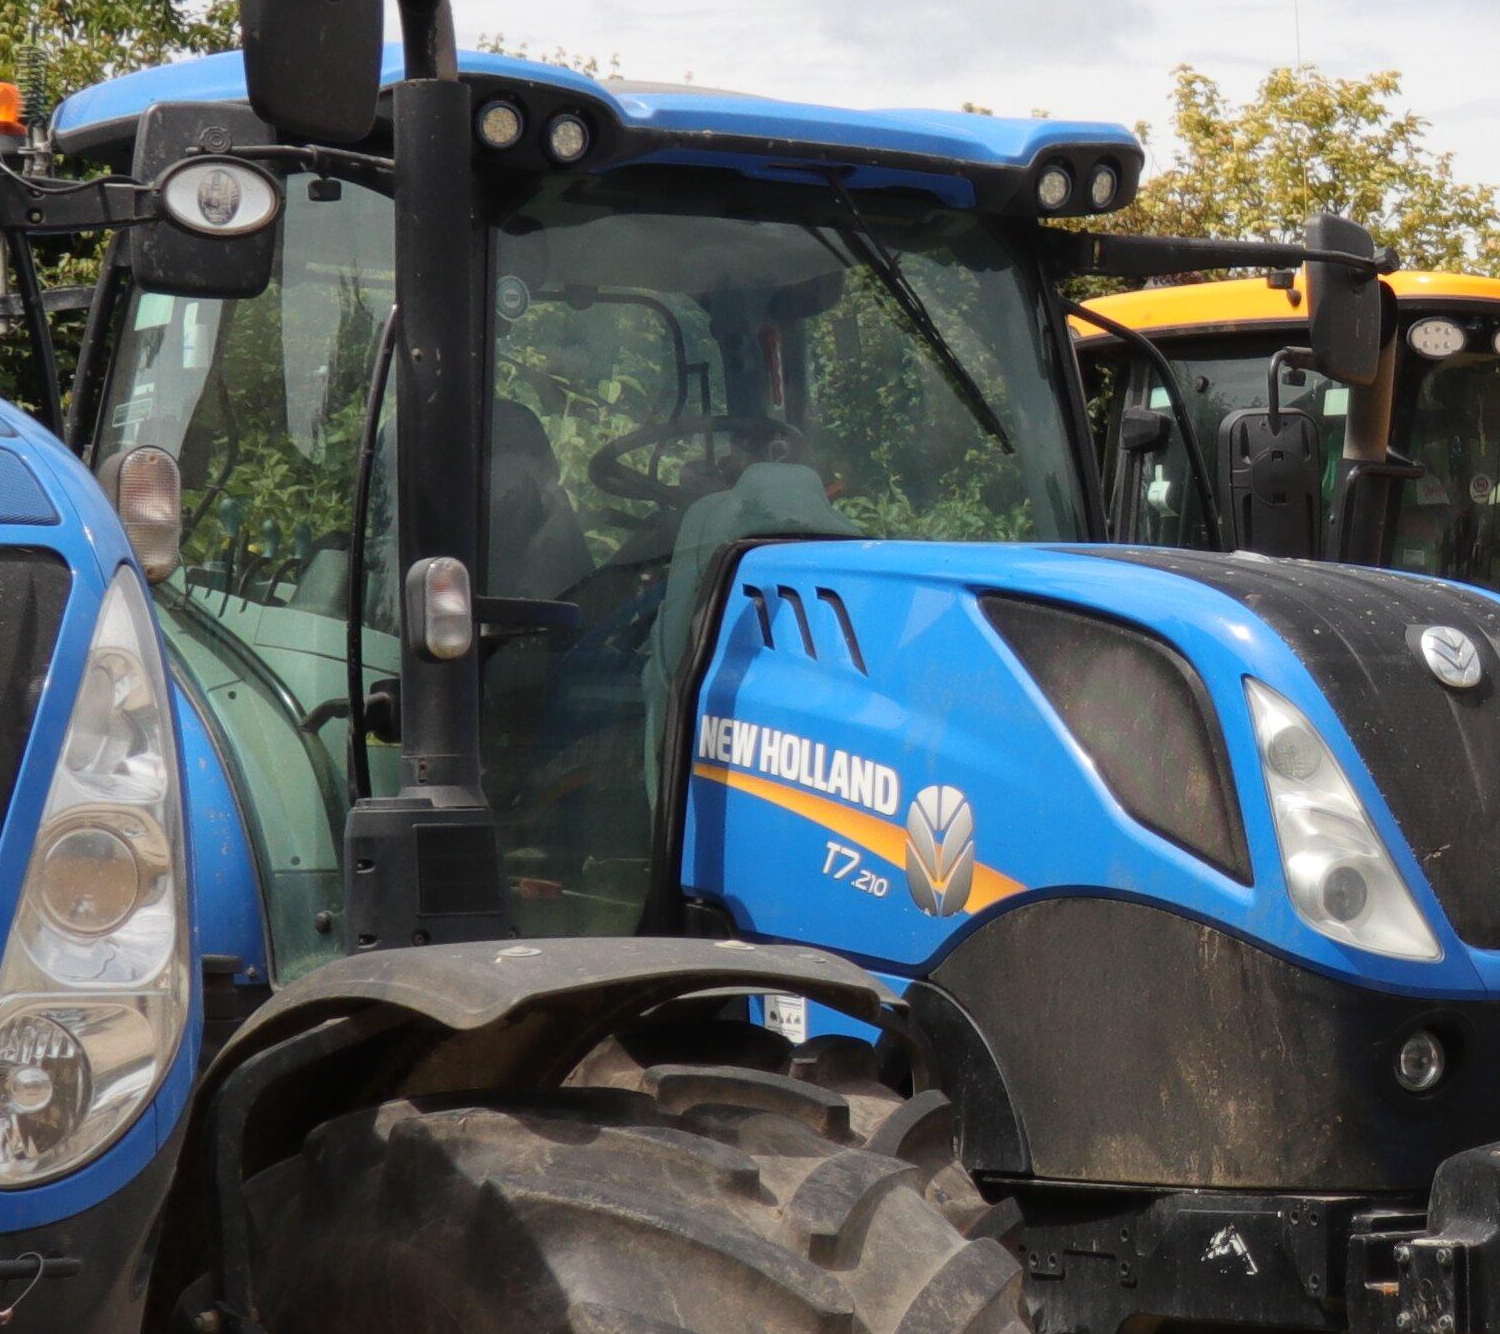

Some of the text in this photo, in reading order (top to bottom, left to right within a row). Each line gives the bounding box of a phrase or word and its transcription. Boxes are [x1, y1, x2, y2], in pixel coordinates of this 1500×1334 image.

[699, 715, 898, 816] NEW HOLLAND
[822, 840, 889, 898] T7.210
